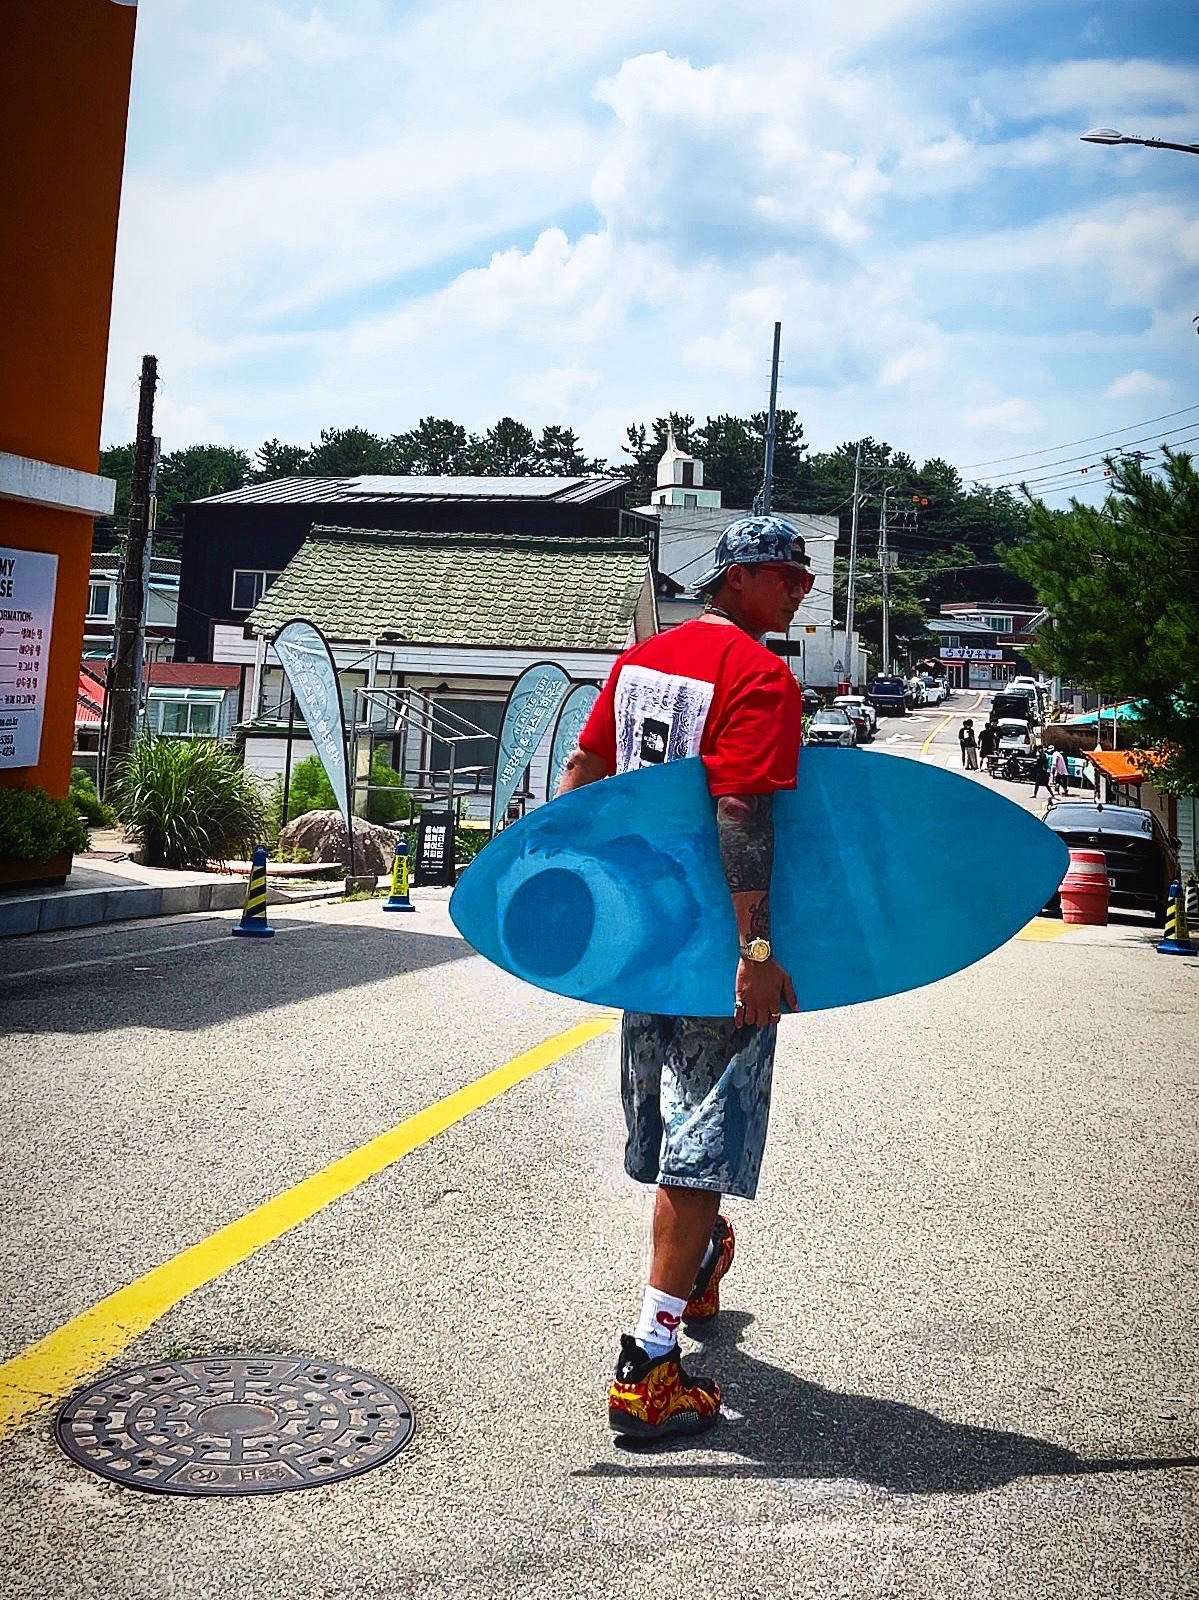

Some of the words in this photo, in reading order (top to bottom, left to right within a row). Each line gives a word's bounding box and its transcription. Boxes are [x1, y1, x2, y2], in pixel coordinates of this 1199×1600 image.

[513, 698, 537, 735] HEALING
[534, 674, 550, 696] SURF
[499, 746, 526, 786] 서핑강습
[519, 737, 530, 747] &
